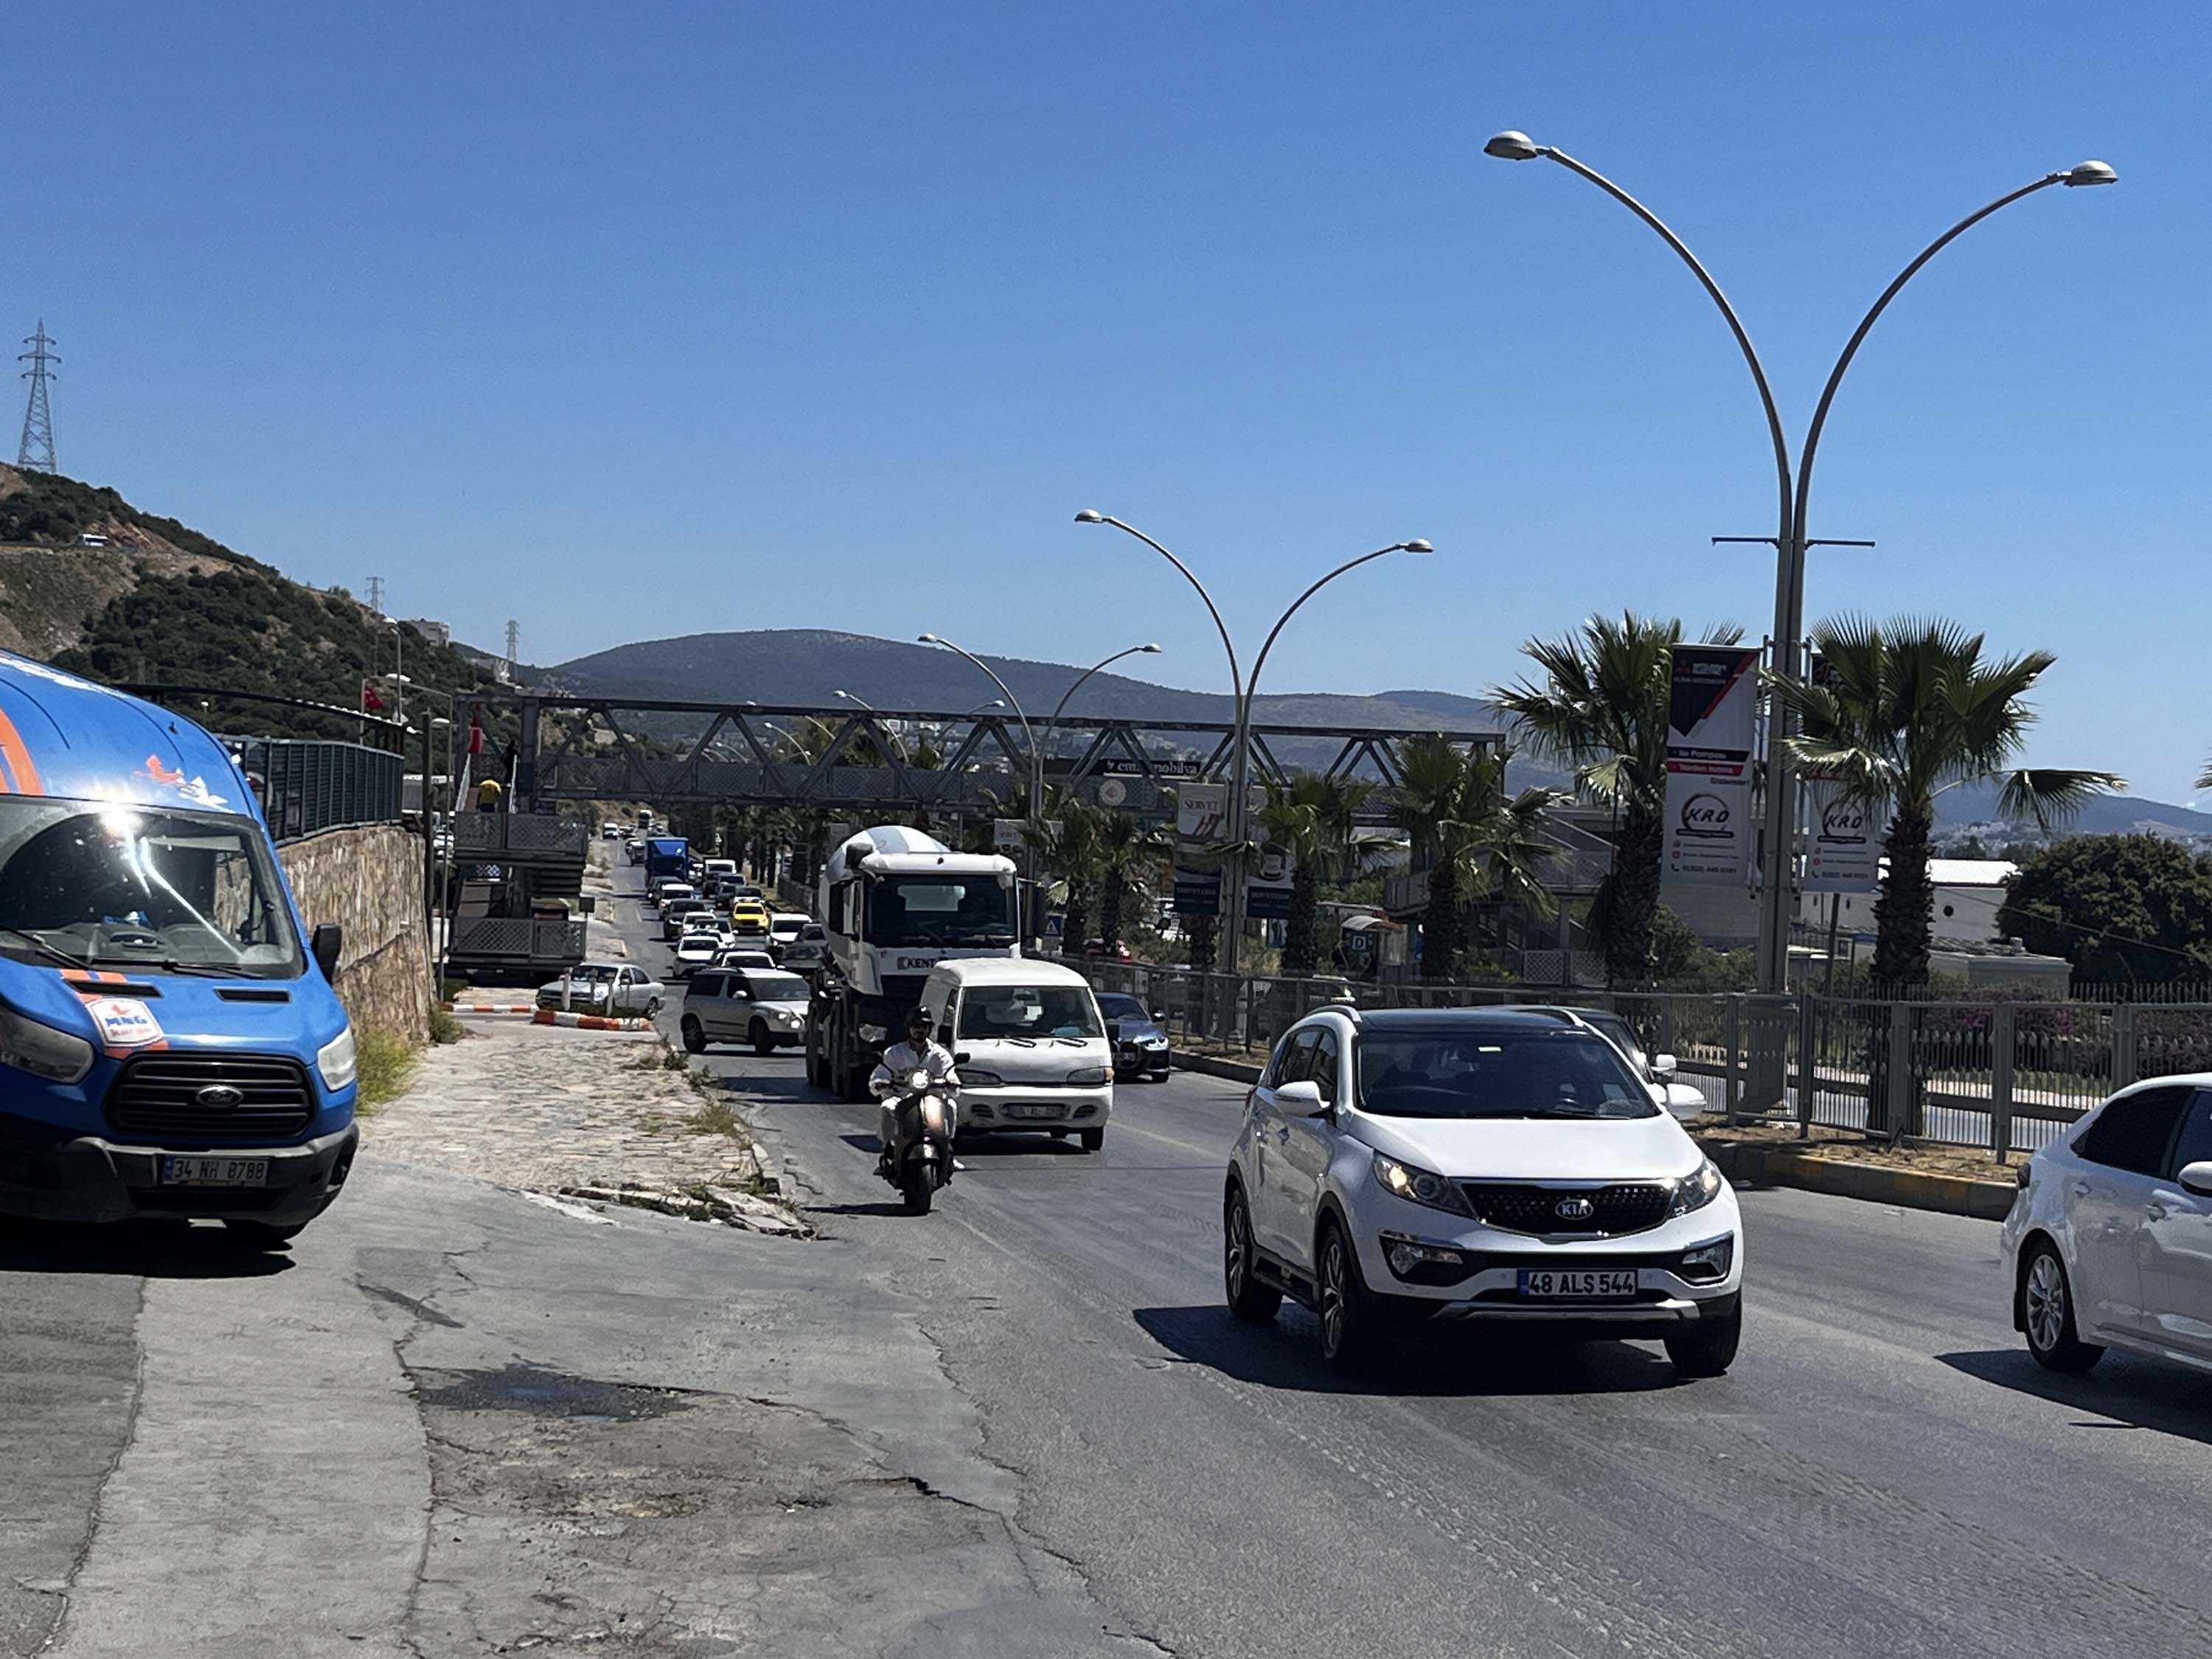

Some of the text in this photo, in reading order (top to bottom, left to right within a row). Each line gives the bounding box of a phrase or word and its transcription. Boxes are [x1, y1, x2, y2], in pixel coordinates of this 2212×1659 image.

[105, 1015, 147, 1027] MNG
[174, 1160, 192, 1178] 34
[1562, 1203, 1587, 1216] KIA
[1529, 1273, 1633, 1293] 48 ALS 544
